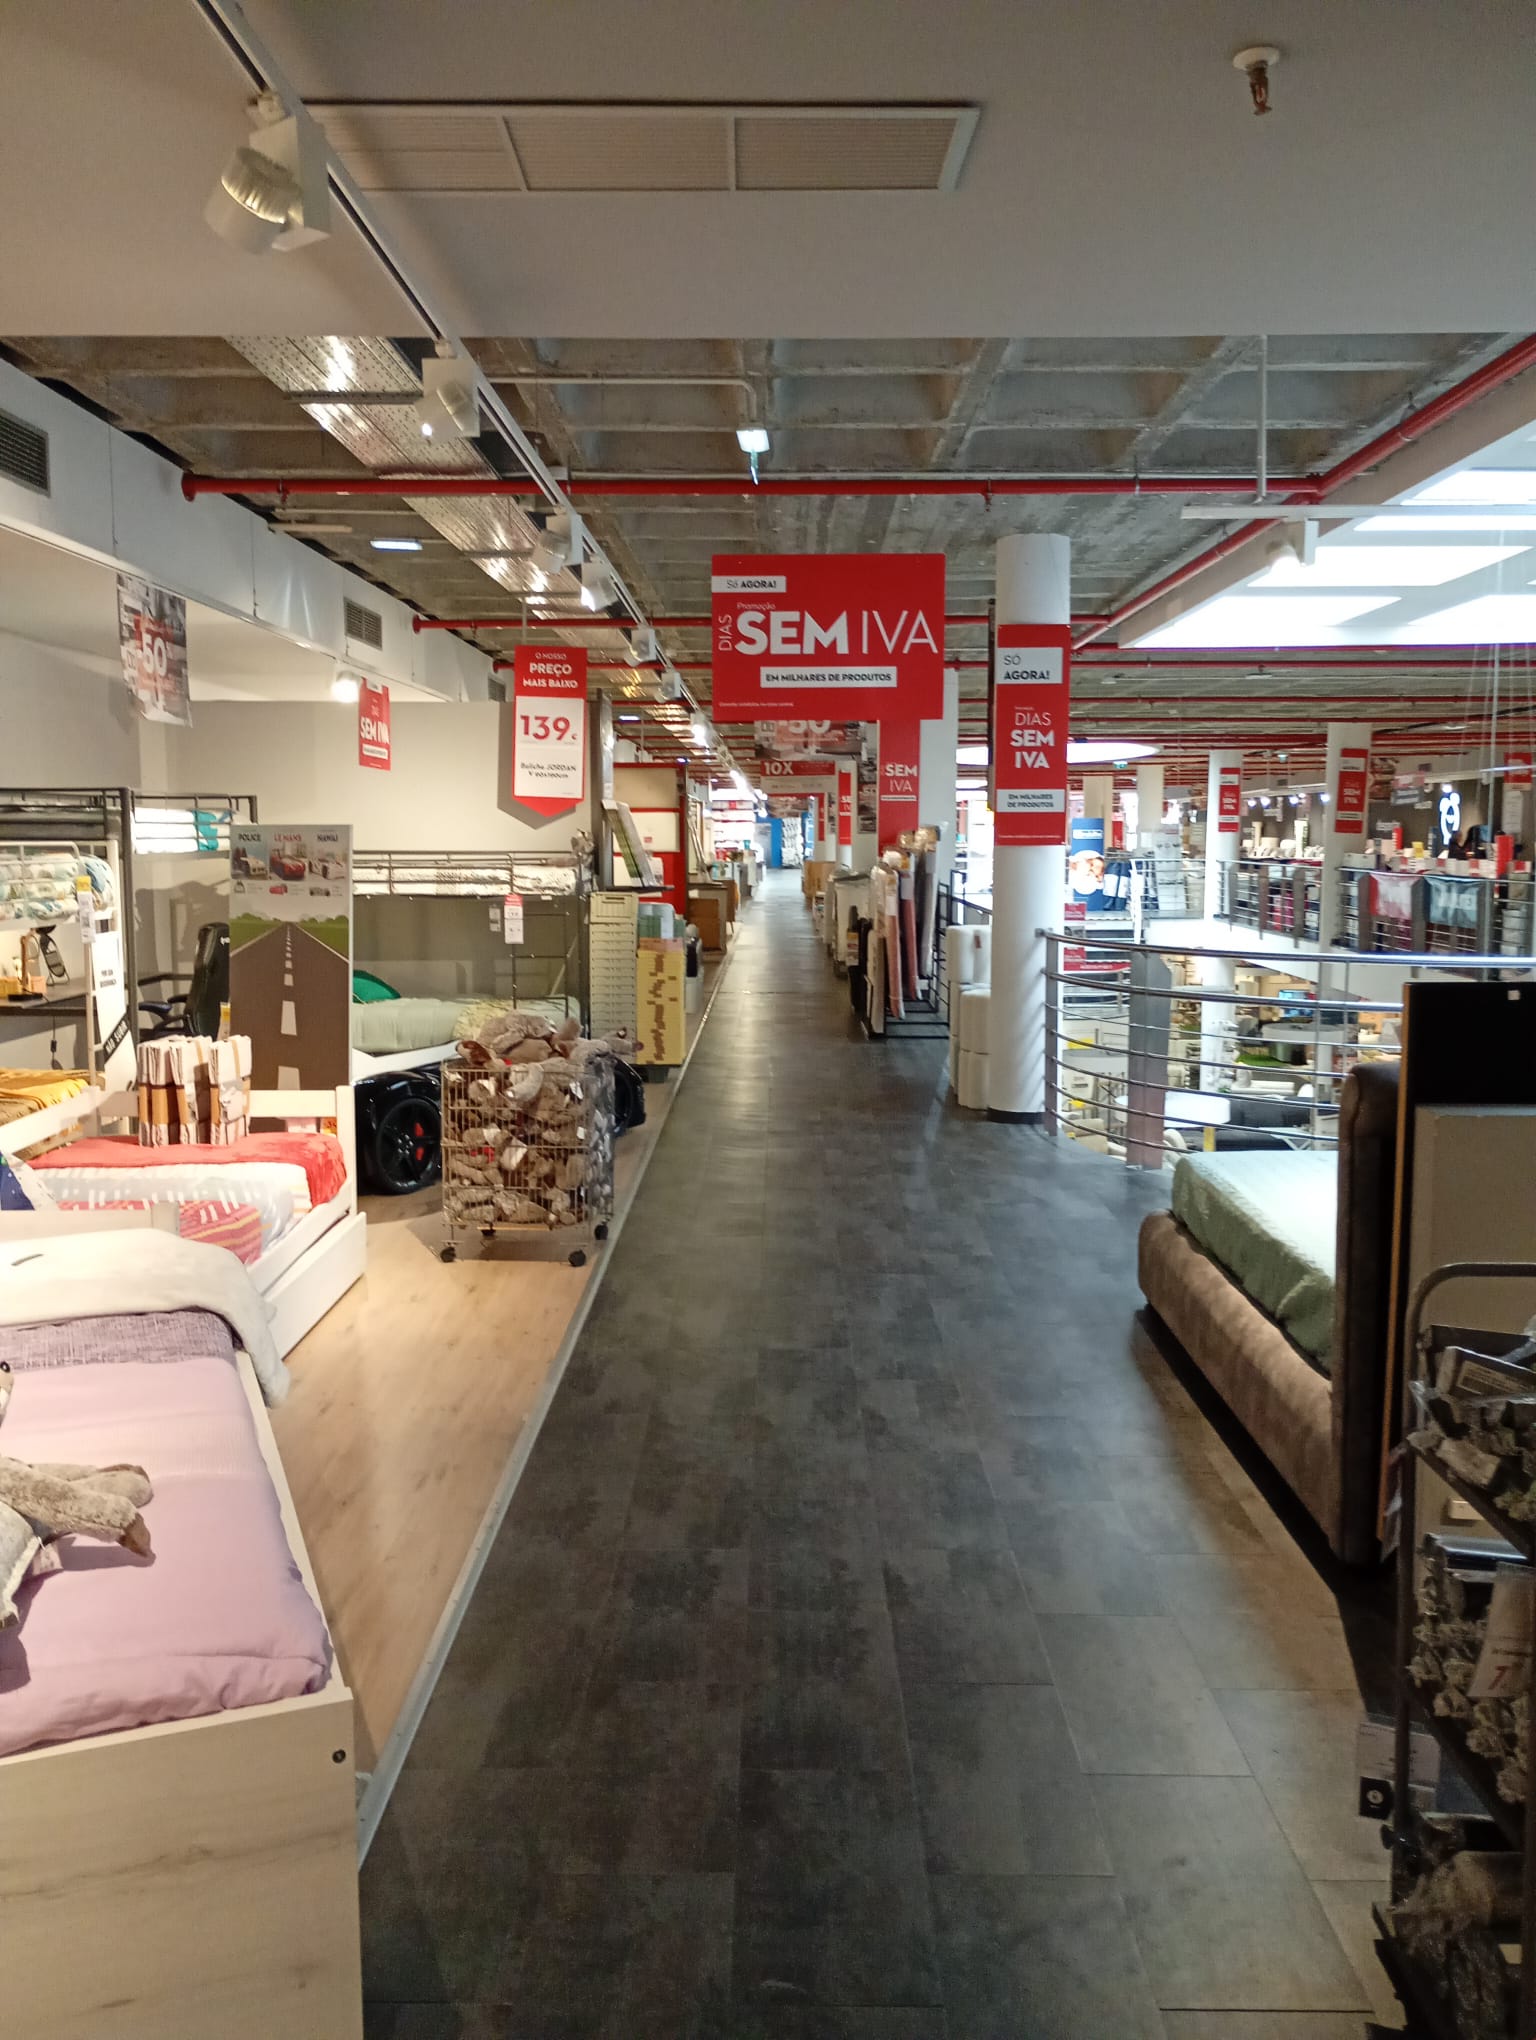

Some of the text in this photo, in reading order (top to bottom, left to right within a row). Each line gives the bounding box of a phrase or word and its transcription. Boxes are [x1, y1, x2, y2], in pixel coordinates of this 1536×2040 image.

[740, 580, 777, 589] AGORA!
[718, 614, 733, 651] DIAS
[735, 610, 938, 655] SEM IVA
[529, 662, 573, 677] PREÇO
[1003, 670, 1051, 680] AGORA!
[522, 677, 579, 689] MAIS BAIXO
[765, 673, 892, 682] EM MILHARES DE PRODUTOS
[1014, 712, 1052, 726] DIAS
[1010, 729, 1055, 747] SEM
[1014, 751, 1050, 769] IVA
[764, 761, 794, 776] 10X
[885, 763, 918, 777] SEM
[889, 779, 913, 793] IVA
